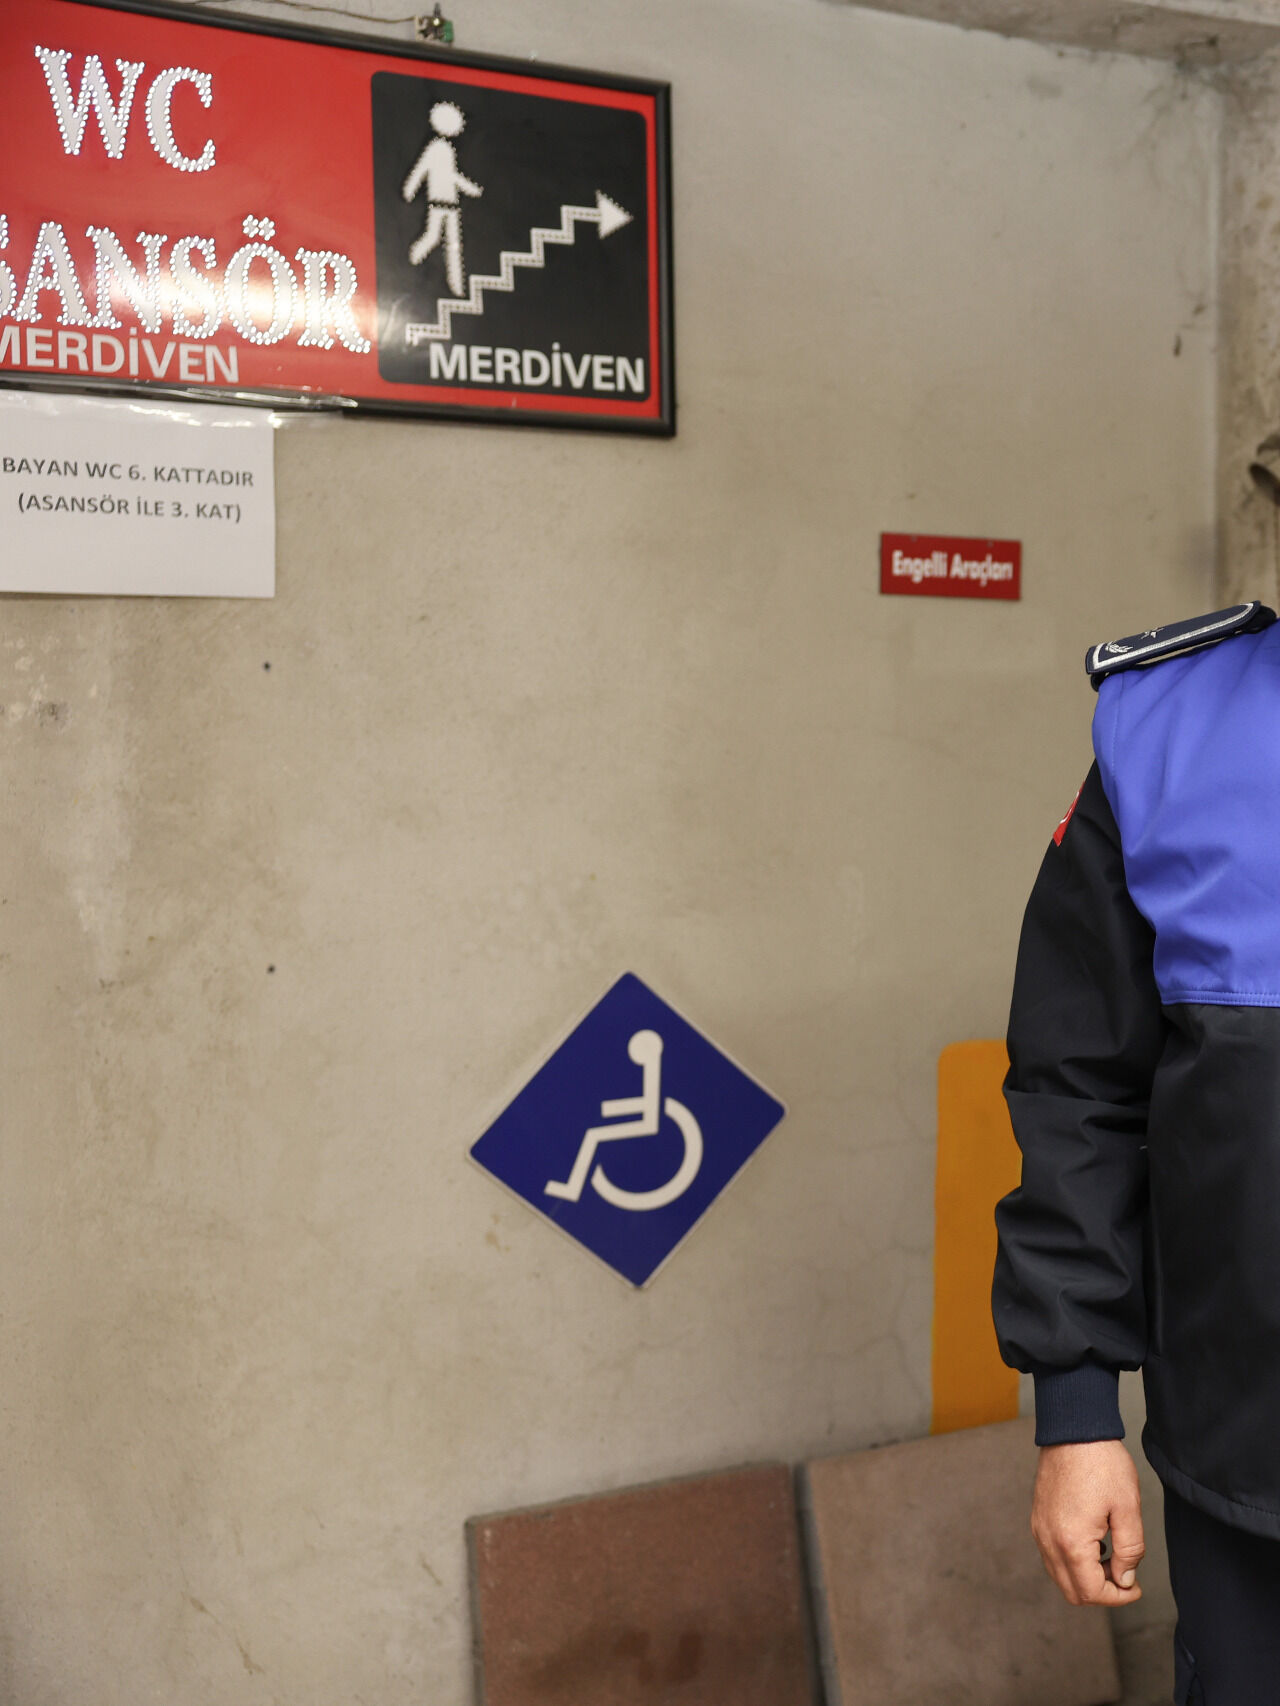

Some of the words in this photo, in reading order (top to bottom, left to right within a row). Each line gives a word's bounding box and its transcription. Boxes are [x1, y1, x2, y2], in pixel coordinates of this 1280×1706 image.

[34, 45, 216, 172] WC
[429, 341, 645, 393] MERDİVEN
[2, 456, 78, 478] BAYAN
[86, 461, 122, 480] WC
[128, 464, 146, 482] 6.
[154, 466, 254, 487] KATTADIR
[18, 492, 130, 516] (ASANSÖR
[137, 496, 165, 517] İLE
[171, 501, 189, 518] 3.
[196, 503, 241, 524] KAT)
[892, 550, 948, 583] Engelli
